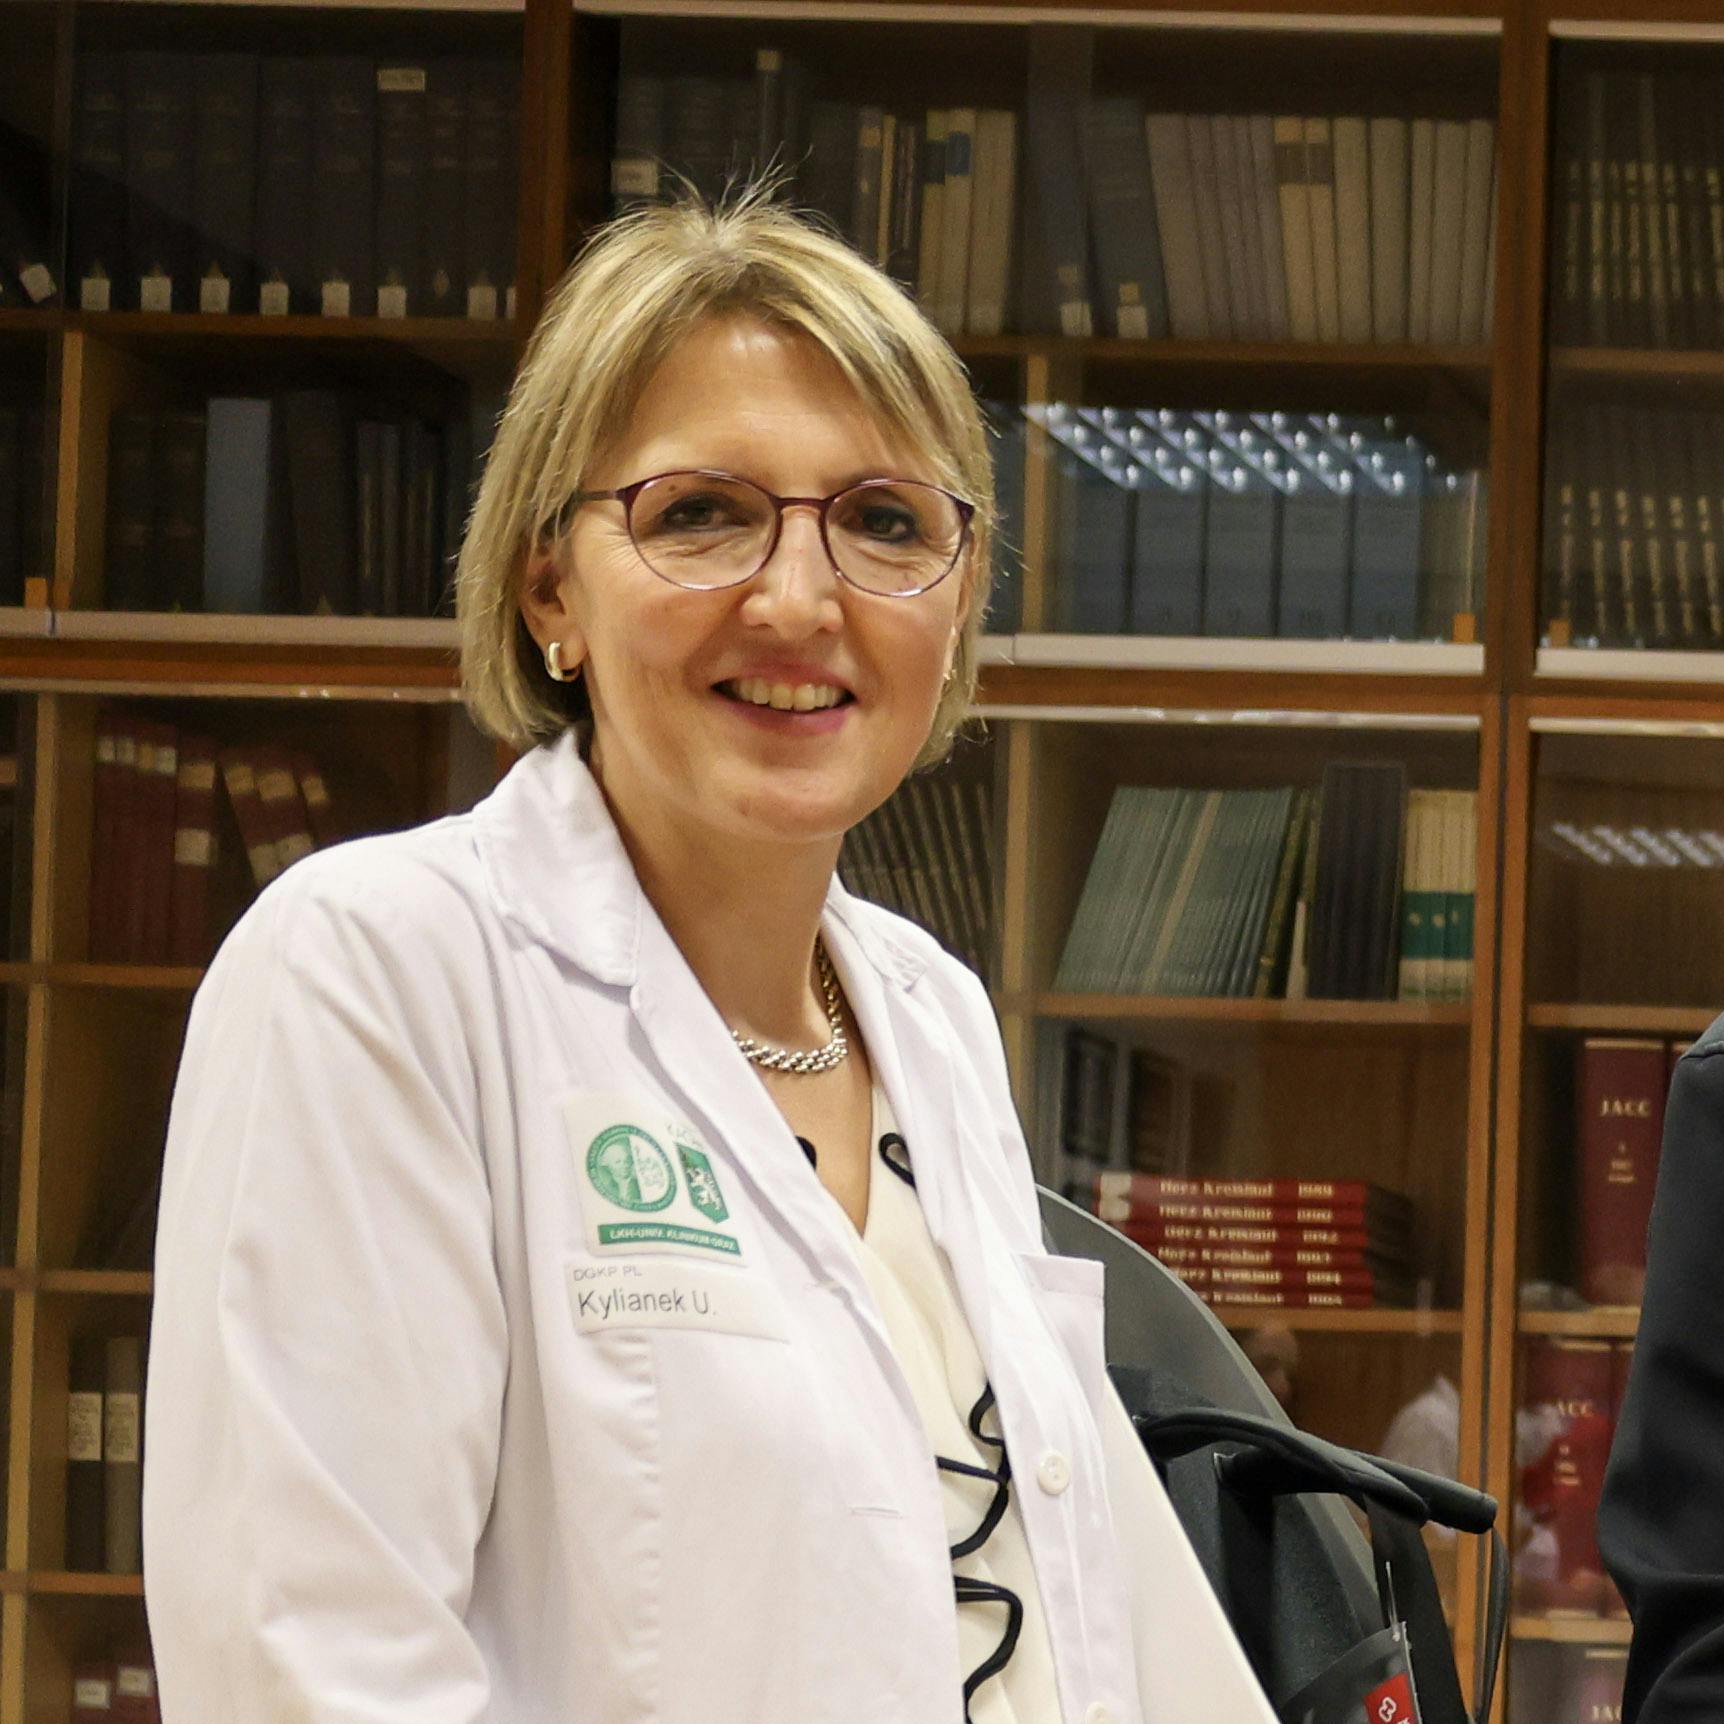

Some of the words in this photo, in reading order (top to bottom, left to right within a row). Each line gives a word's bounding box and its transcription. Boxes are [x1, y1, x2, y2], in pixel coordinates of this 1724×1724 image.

[1600, 1098, 1651, 1117] JACC
[573, 1266, 617, 1281] DGKP
[622, 1265, 642, 1277] PL
[578, 1288, 686, 1320] Kylianek
[692, 1289, 717, 1316] U.
